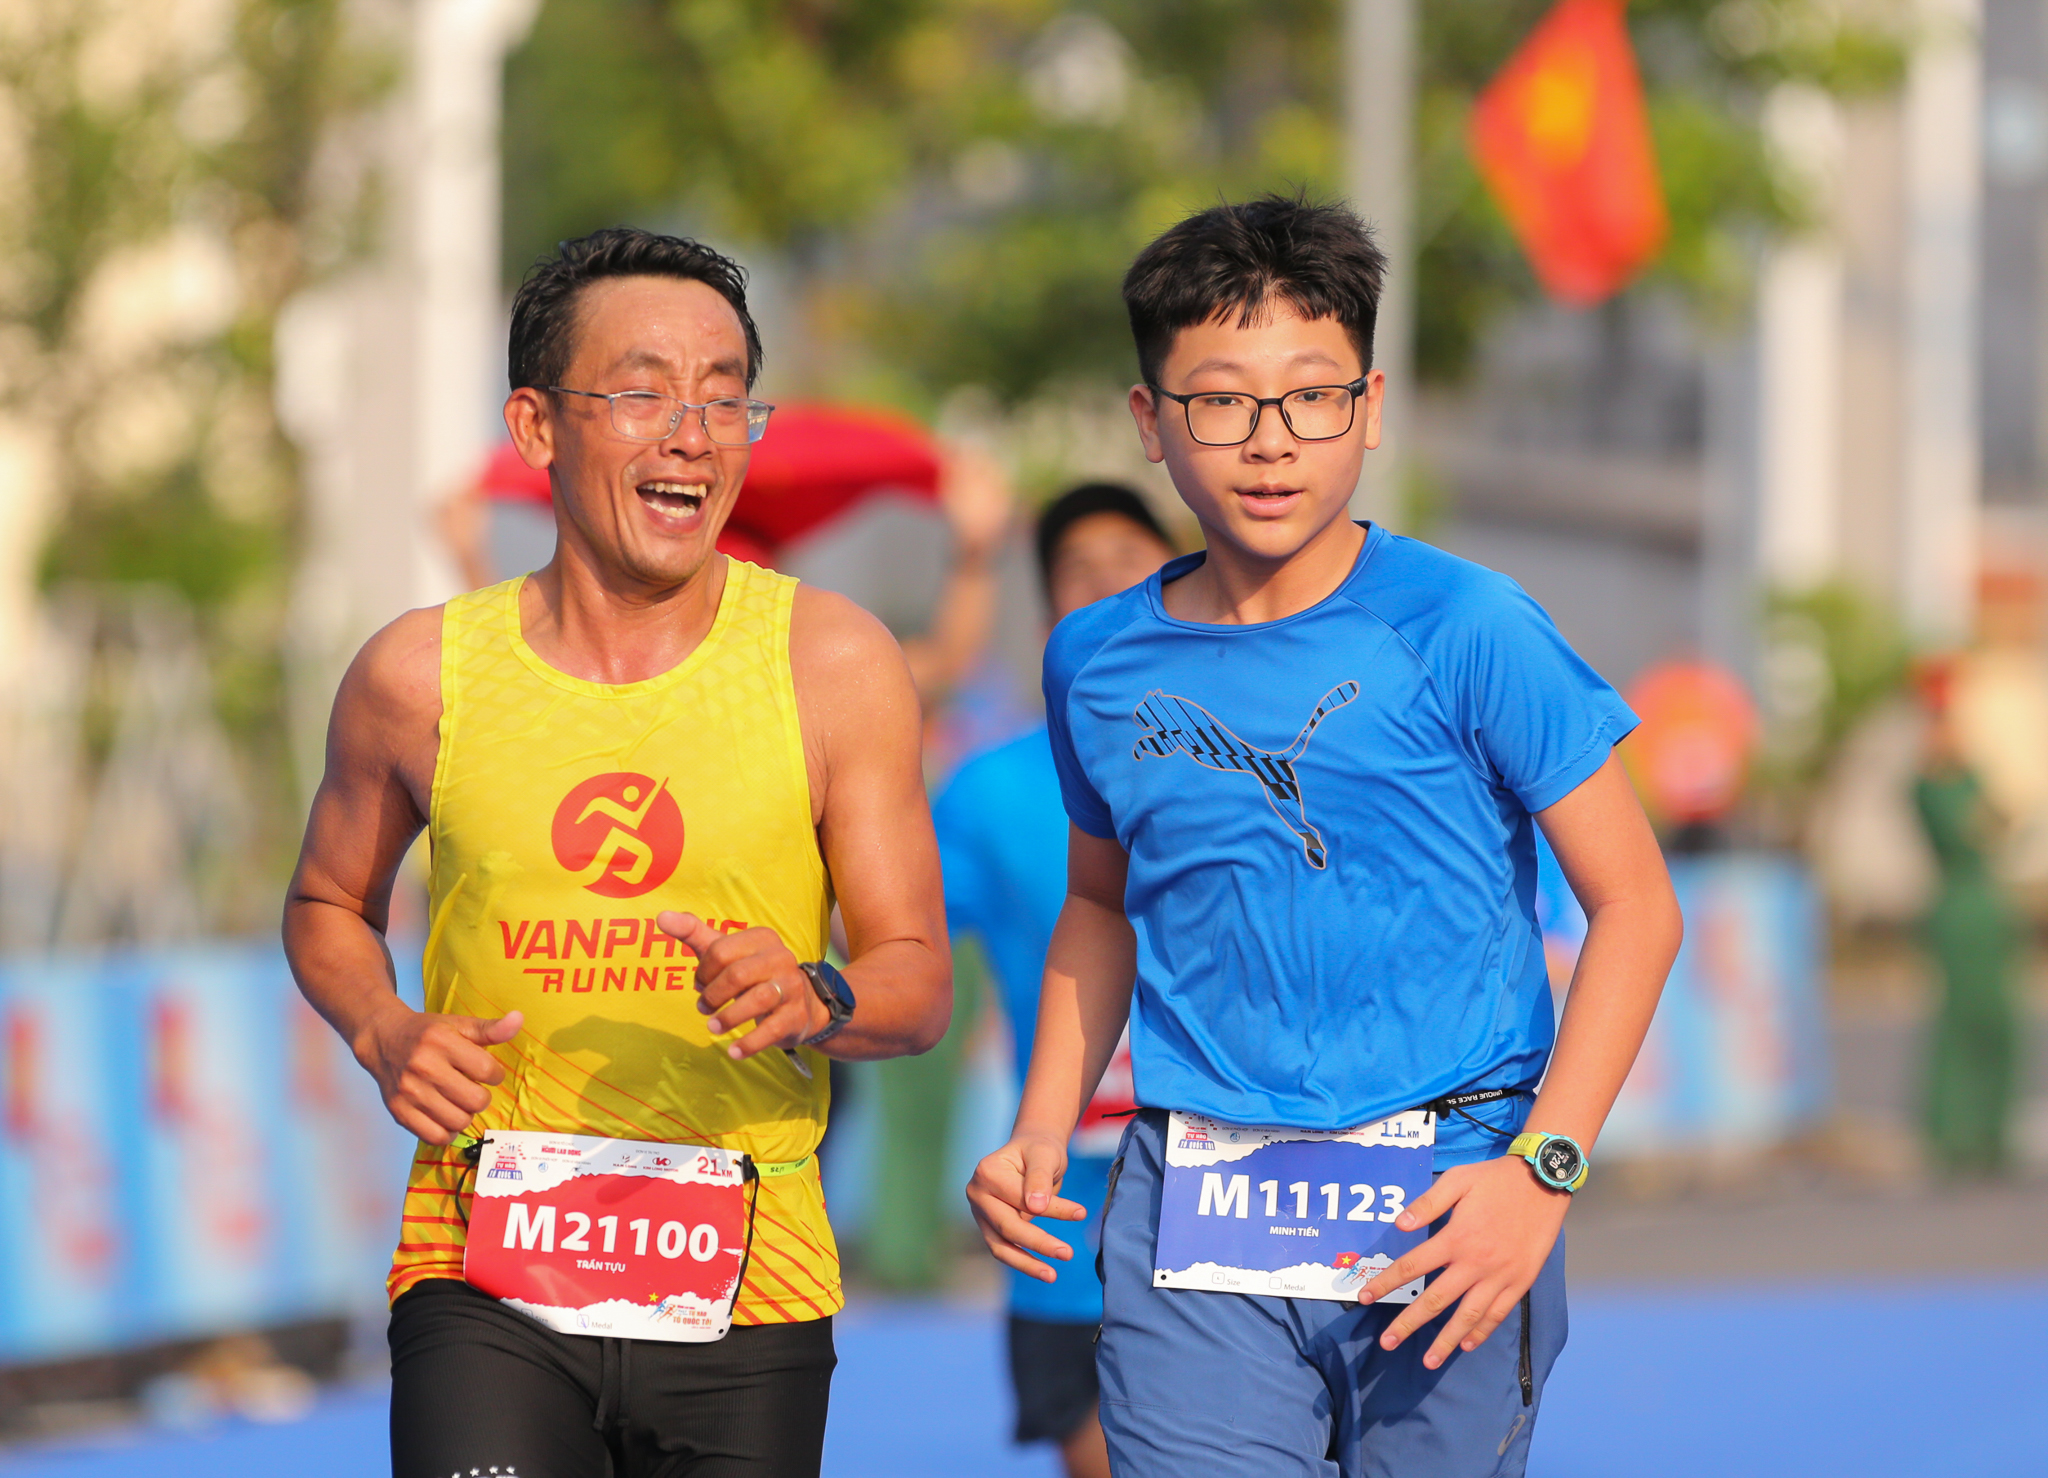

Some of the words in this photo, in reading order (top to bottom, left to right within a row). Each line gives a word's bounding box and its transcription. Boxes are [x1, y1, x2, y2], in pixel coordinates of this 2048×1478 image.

[522, 966, 697, 993] RUNNE
[1457, 1094, 1478, 1104] RACE
[1197, 1171, 1406, 1223] M11123
[502, 1202, 719, 1262] M21100
[1269, 1226, 1296, 1236] MINH
[1297, 1226, 1319, 1237] TIẾN
[1226, 1278, 1241, 1286] Size
[1283, 1283, 1306, 1292] Medal
[591, 1321, 613, 1330] Medal
